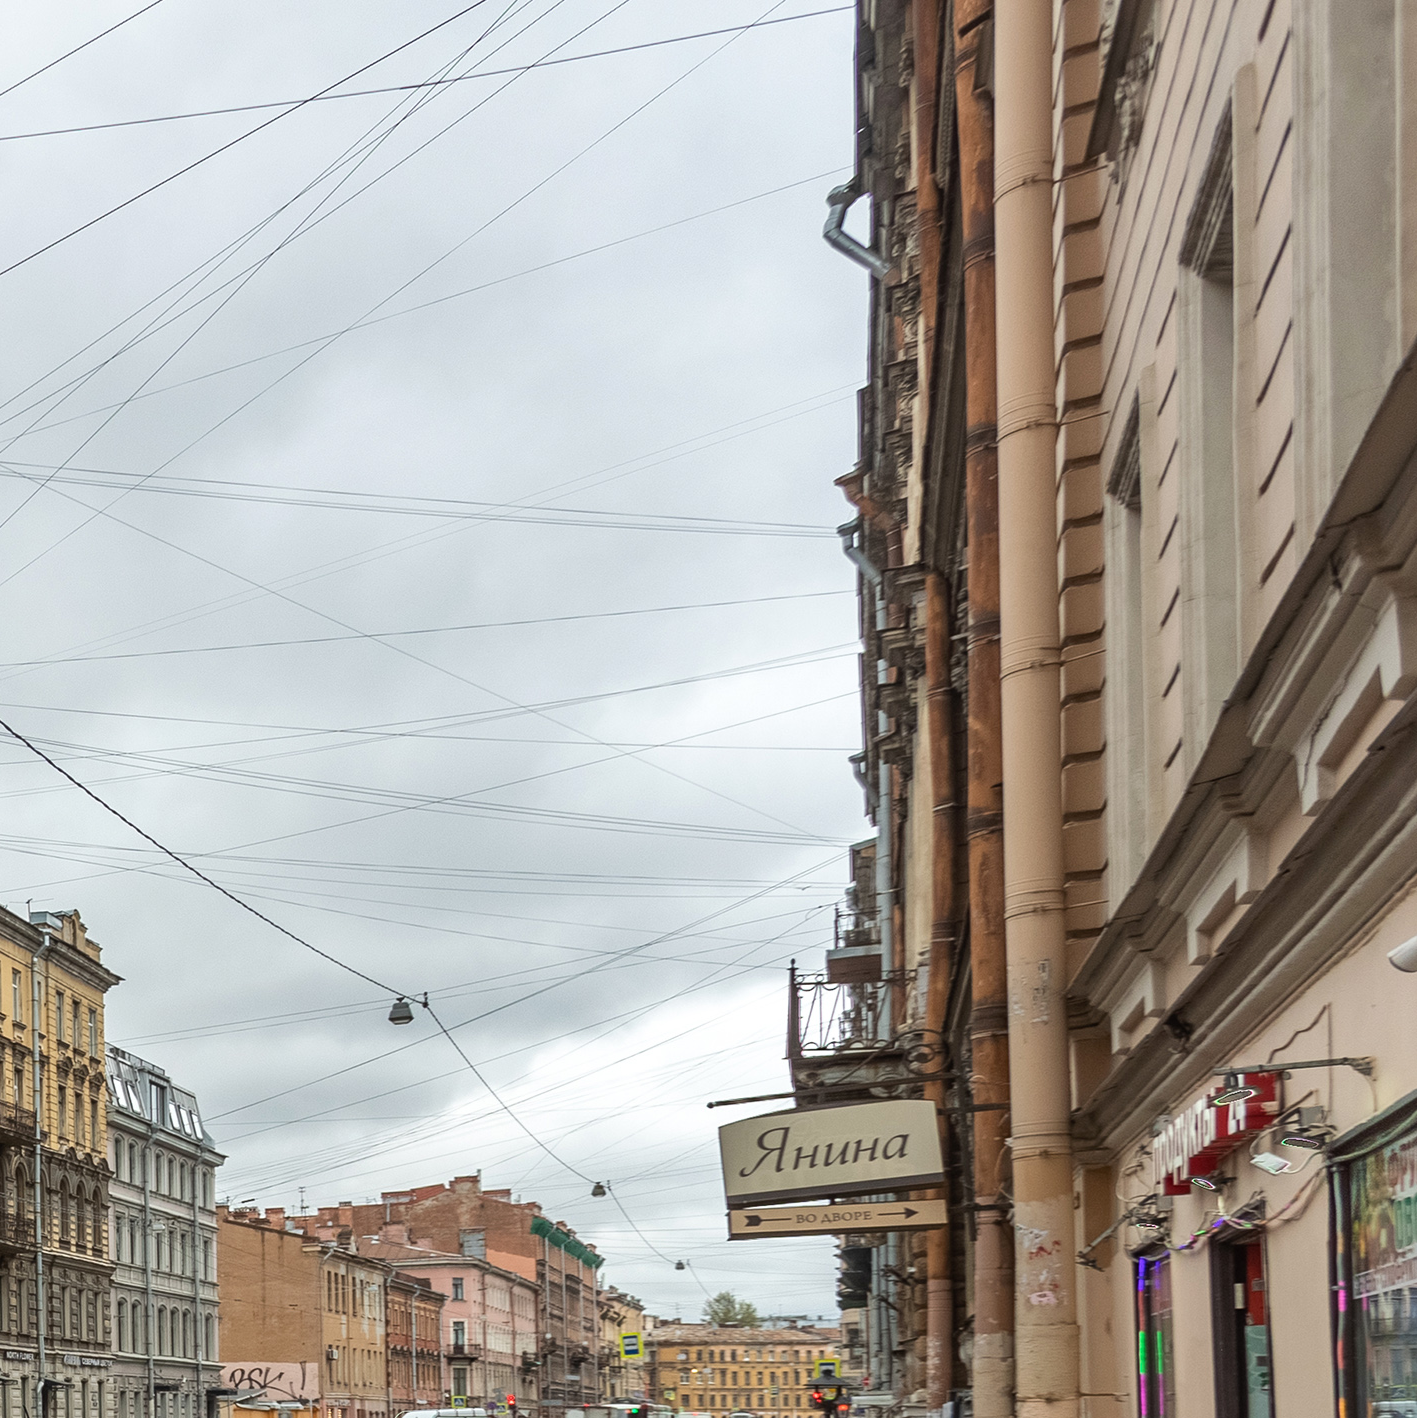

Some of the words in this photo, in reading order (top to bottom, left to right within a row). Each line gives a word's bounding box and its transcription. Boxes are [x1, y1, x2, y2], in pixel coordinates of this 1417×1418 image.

[738, 1126, 911, 1178] Янина
[1152, 1086, 1217, 1197] ПРОДУКТЫ
[795, 1213, 818, 1225] ВО
[820, 1210, 873, 1225] ДВОРЕ
